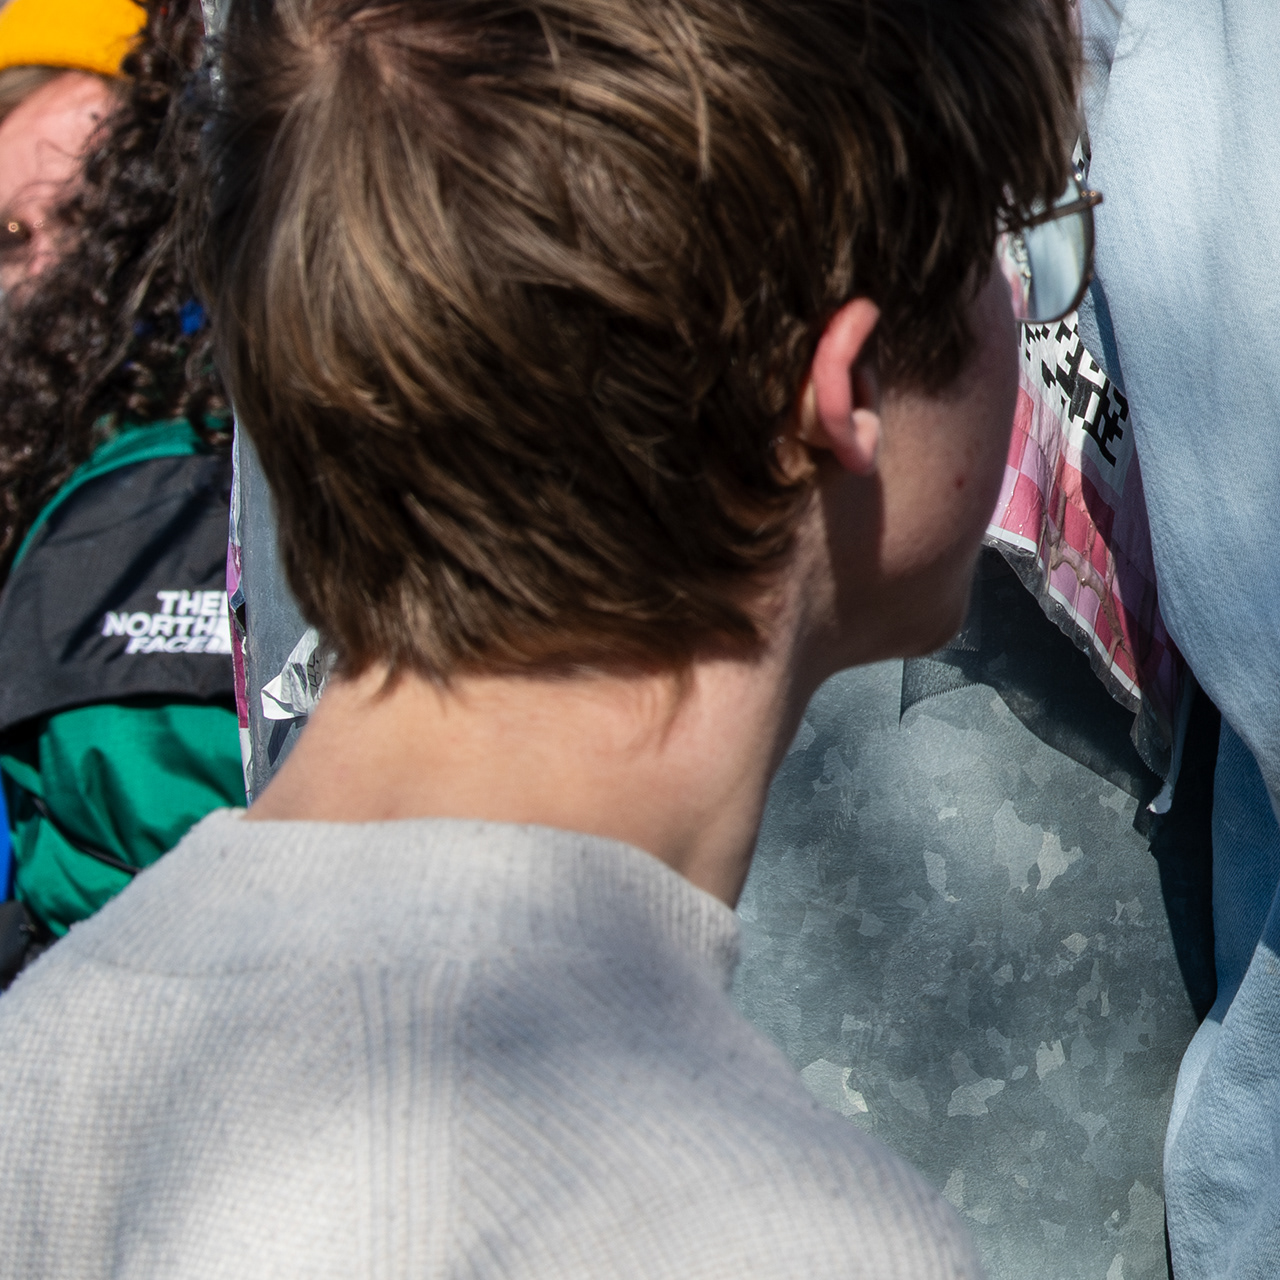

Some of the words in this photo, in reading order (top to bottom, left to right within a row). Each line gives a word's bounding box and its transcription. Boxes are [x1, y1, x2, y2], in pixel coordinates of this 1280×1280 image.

[157, 589, 220, 617] THE
[102, 611, 216, 637] NORTH
[125, 635, 208, 655] FACE
